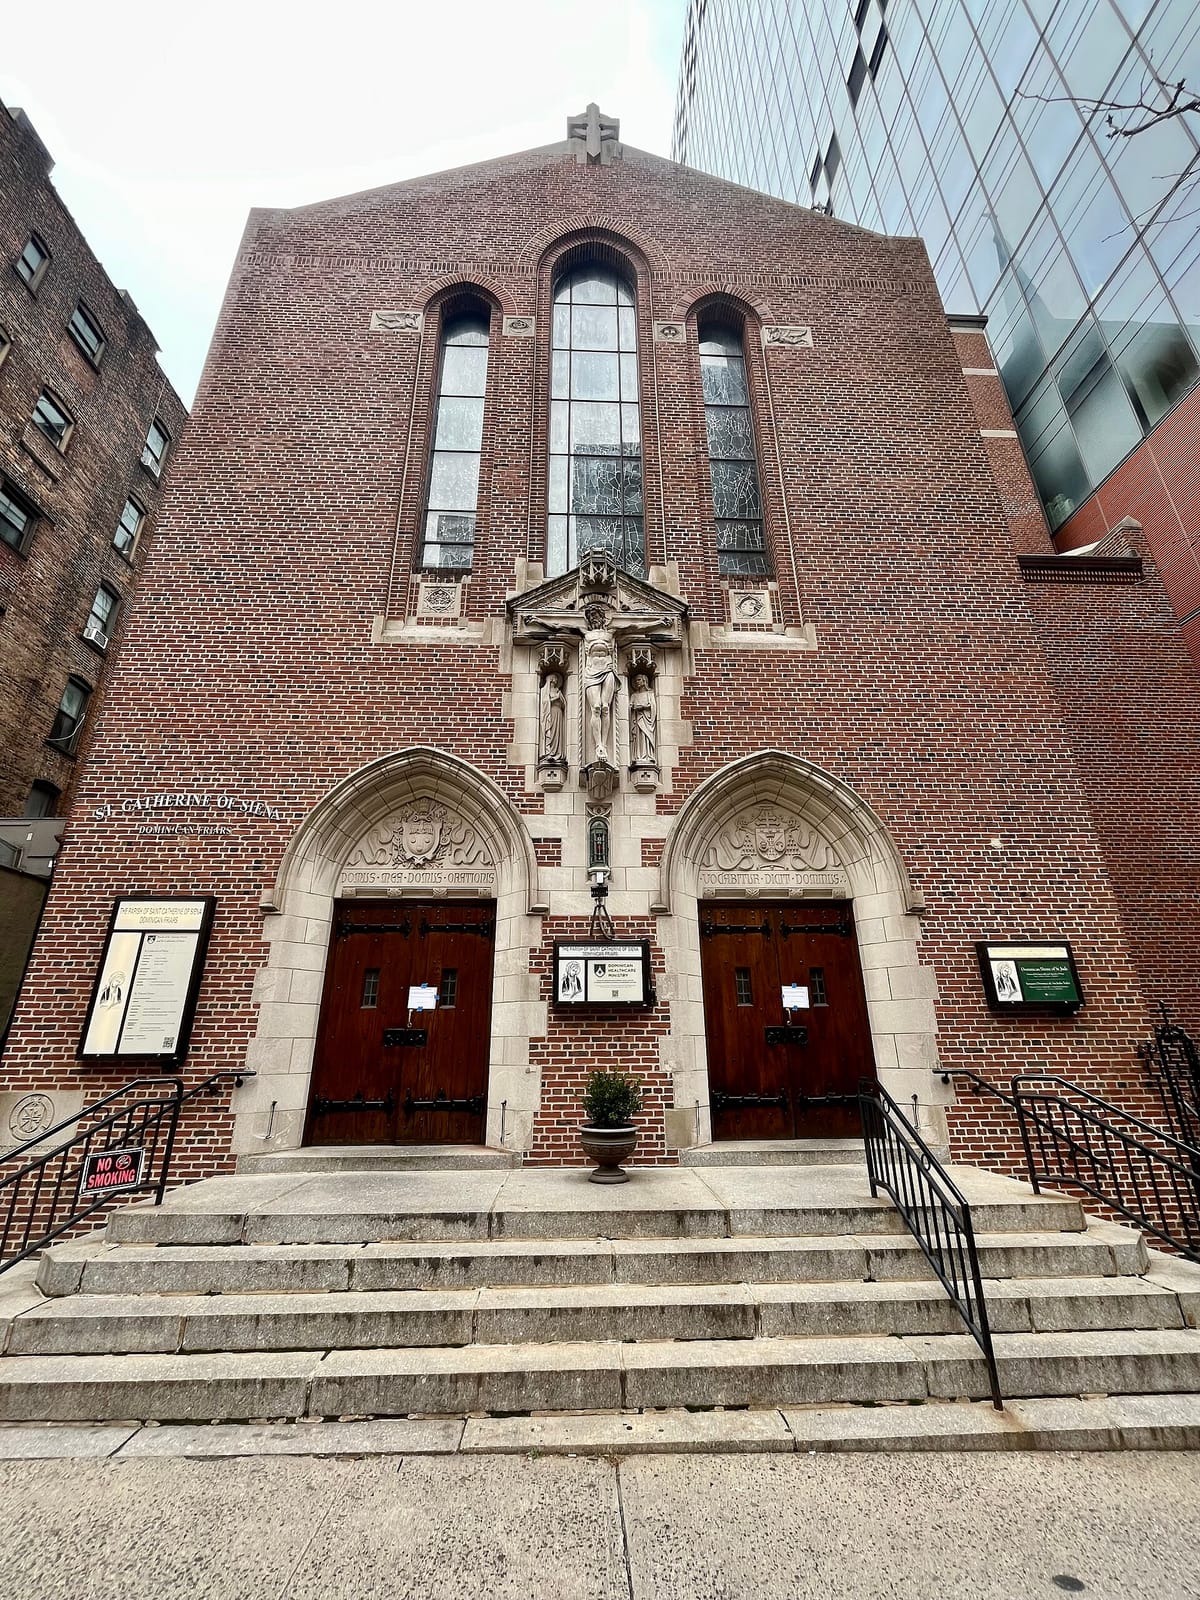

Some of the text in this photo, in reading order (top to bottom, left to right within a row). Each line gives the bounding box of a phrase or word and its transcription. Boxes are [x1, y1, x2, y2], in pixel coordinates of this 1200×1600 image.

[94, 794, 281, 821] ST CATHERINE OF SIENA
[138, 825, 233, 835] DOMINICAN FRIARS
[341, 872, 376, 883] DOMUS
[407, 872, 443, 883] DOMUS
[96, 1157, 112, 1172] NO
[87, 1169, 136, 1189] SMOKING
